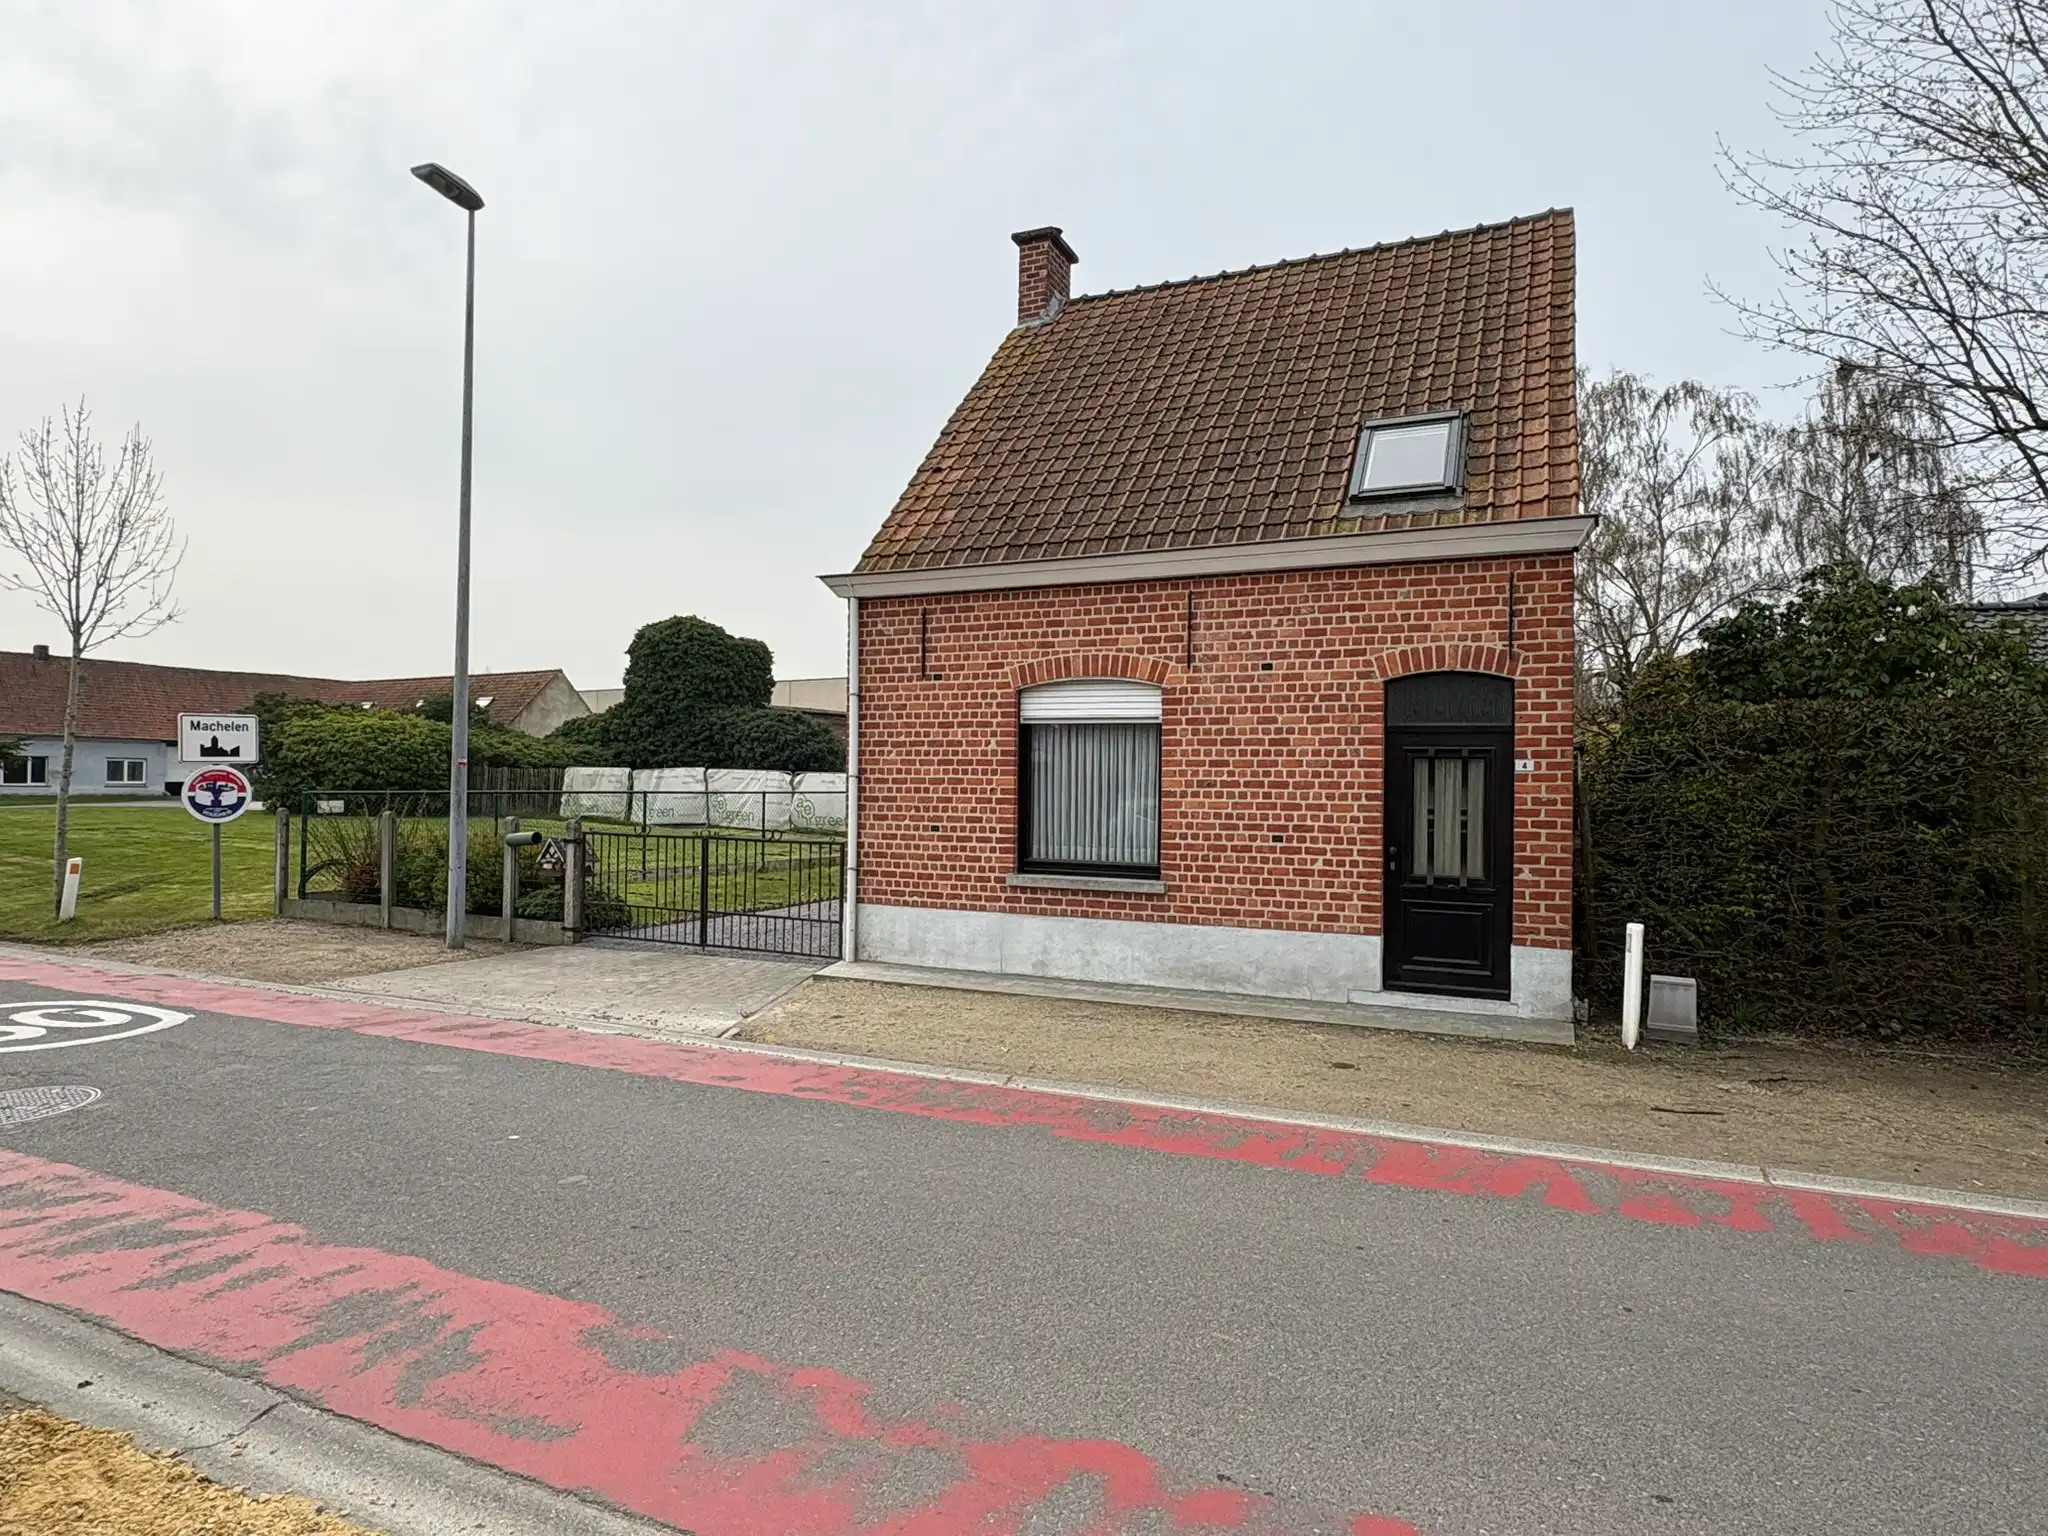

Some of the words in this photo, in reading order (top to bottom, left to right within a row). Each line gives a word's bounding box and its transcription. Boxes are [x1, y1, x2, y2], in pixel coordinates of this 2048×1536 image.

[190, 720, 249, 732] Machelen
[725, 811, 755, 823] green
[815, 816, 844, 830] gree
